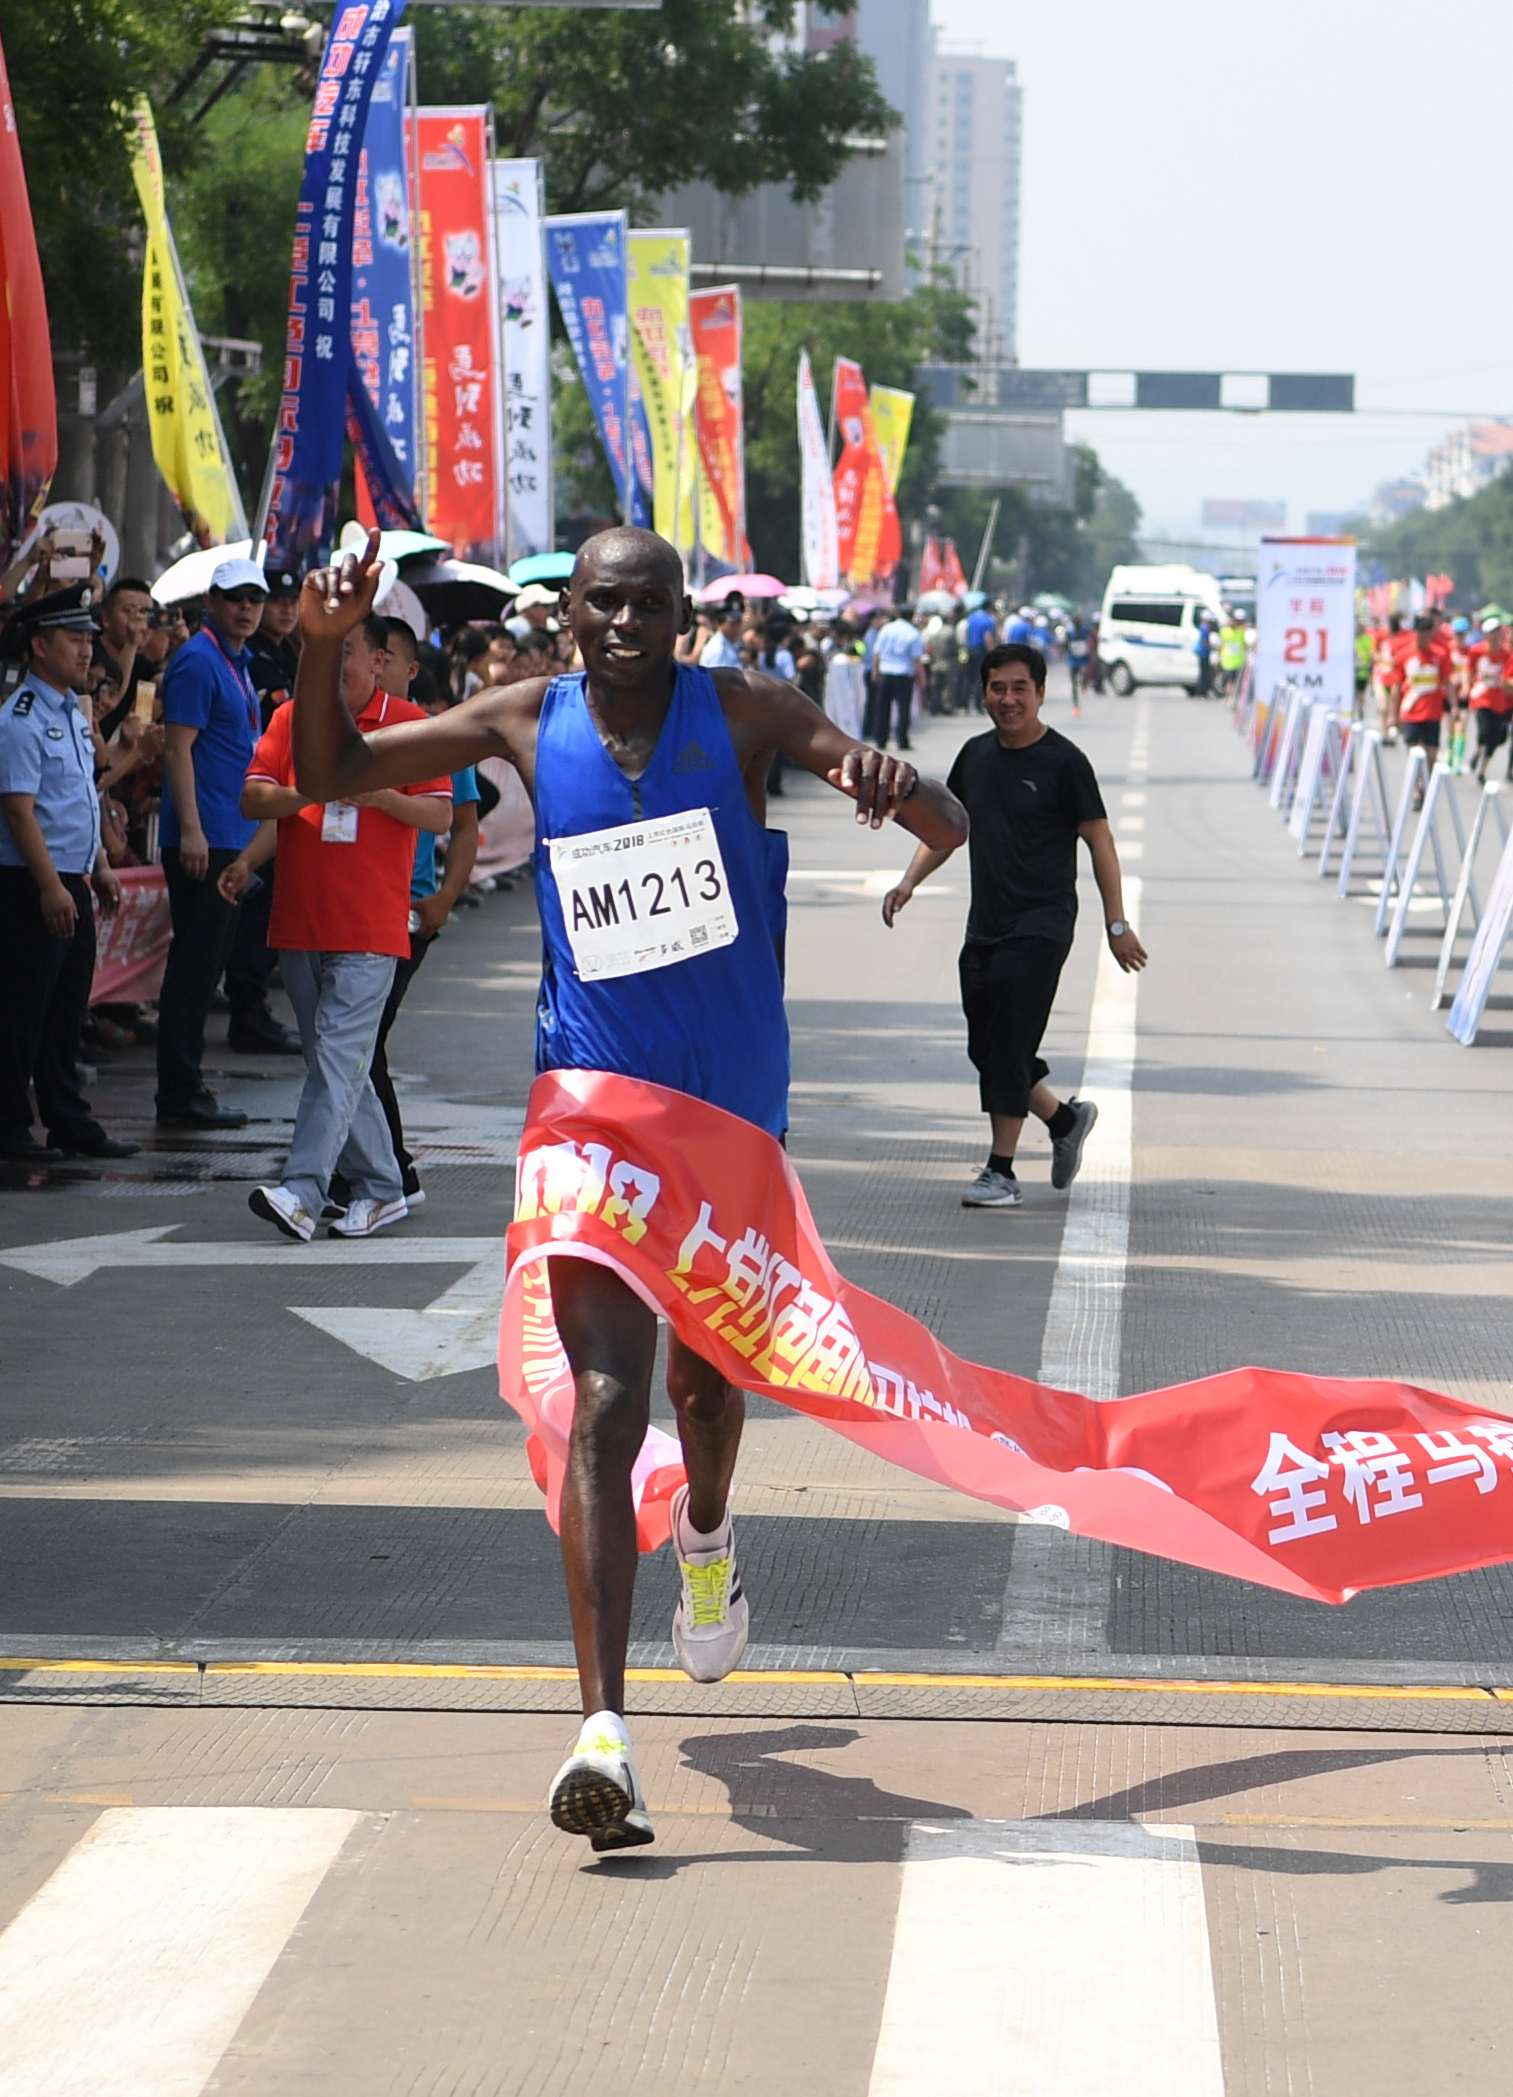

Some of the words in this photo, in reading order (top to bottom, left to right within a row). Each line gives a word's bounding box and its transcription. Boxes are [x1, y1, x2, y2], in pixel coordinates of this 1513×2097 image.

[306, 4, 369, 154] 成功汽车
[314, 335, 333, 360] 祝
[1283, 627, 1330, 664] 21
[1286, 673, 1323, 688] KM
[571, 842, 612, 859] 成功汽车
[613, 834, 644, 852] 2018
[573, 860, 722, 932] AM1213
[513, 1140, 660, 1246] 018
